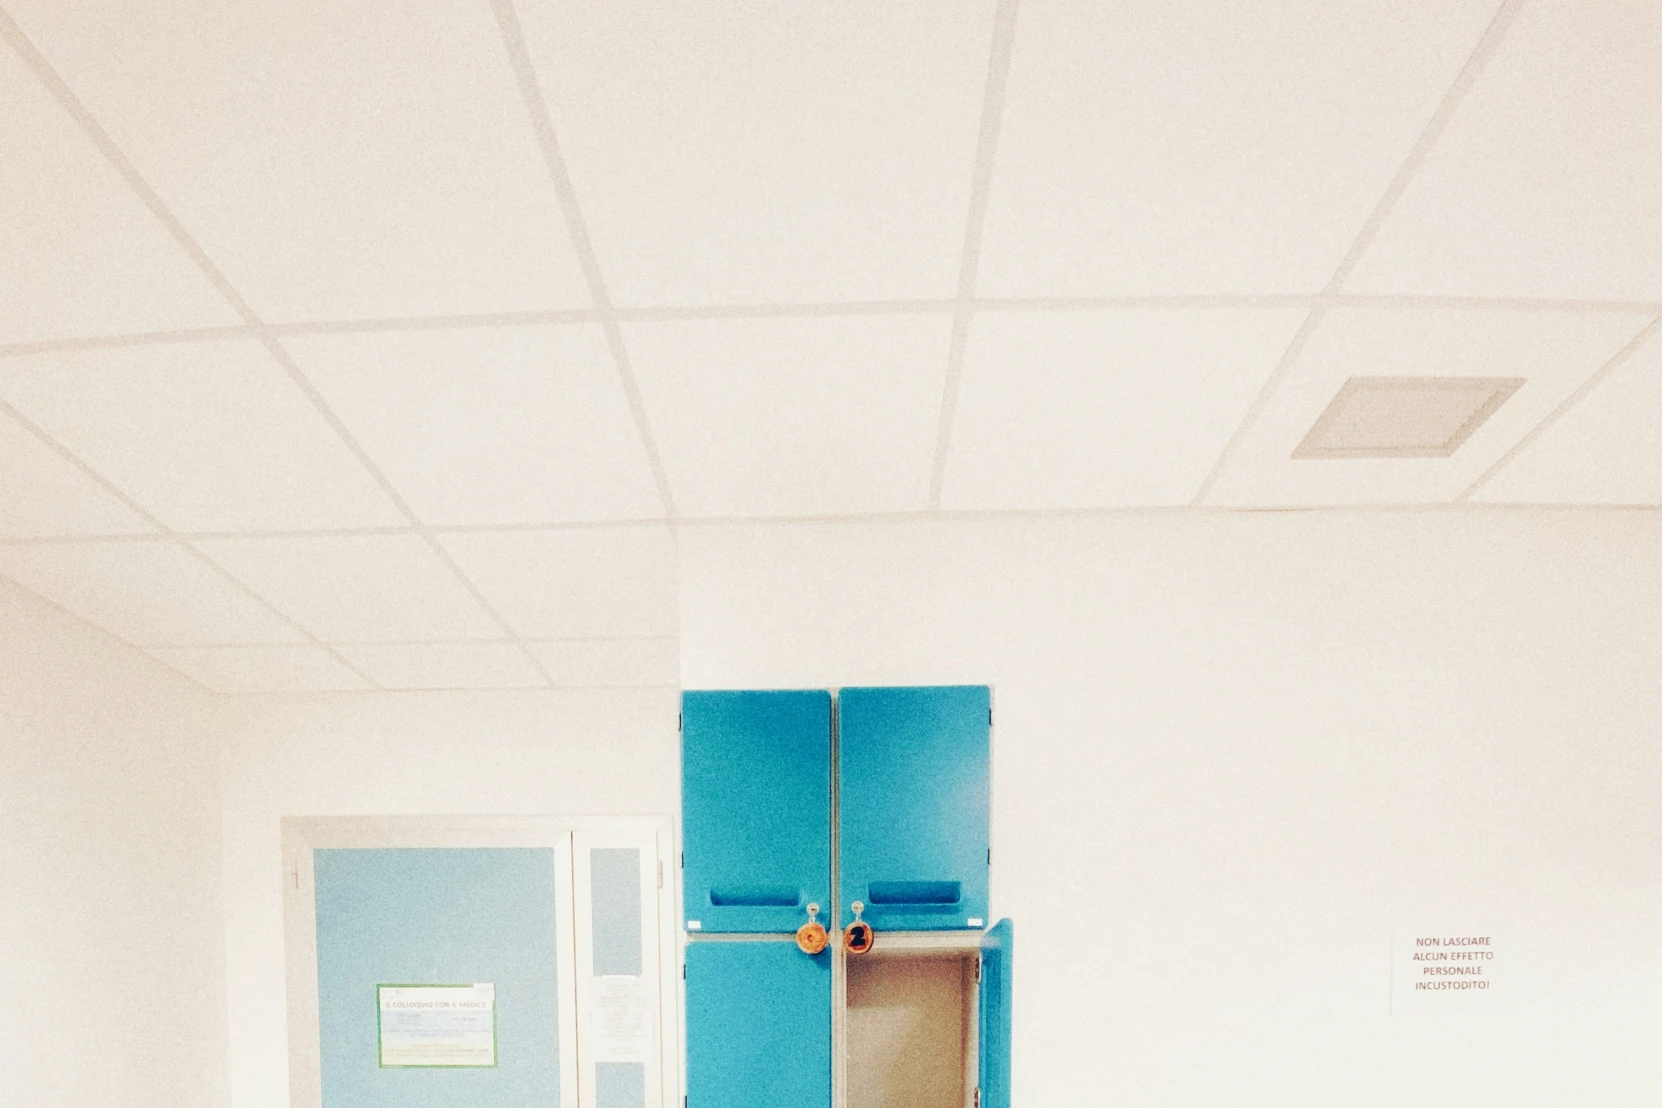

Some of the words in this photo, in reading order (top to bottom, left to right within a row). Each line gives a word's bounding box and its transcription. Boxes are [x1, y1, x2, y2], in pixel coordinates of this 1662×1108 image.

[849, 926, 866, 947] 2
[1416, 938, 1440, 947] NON
[1443, 936, 1491, 946] LASCIARE
[1413, 952, 1448, 961] ALCUN
[1450, 951, 1494, 961] EFFETTO
[1423, 966, 1483, 976] PERSONALE
[1415, 980, 1490, 990] INCUSTODITO!
